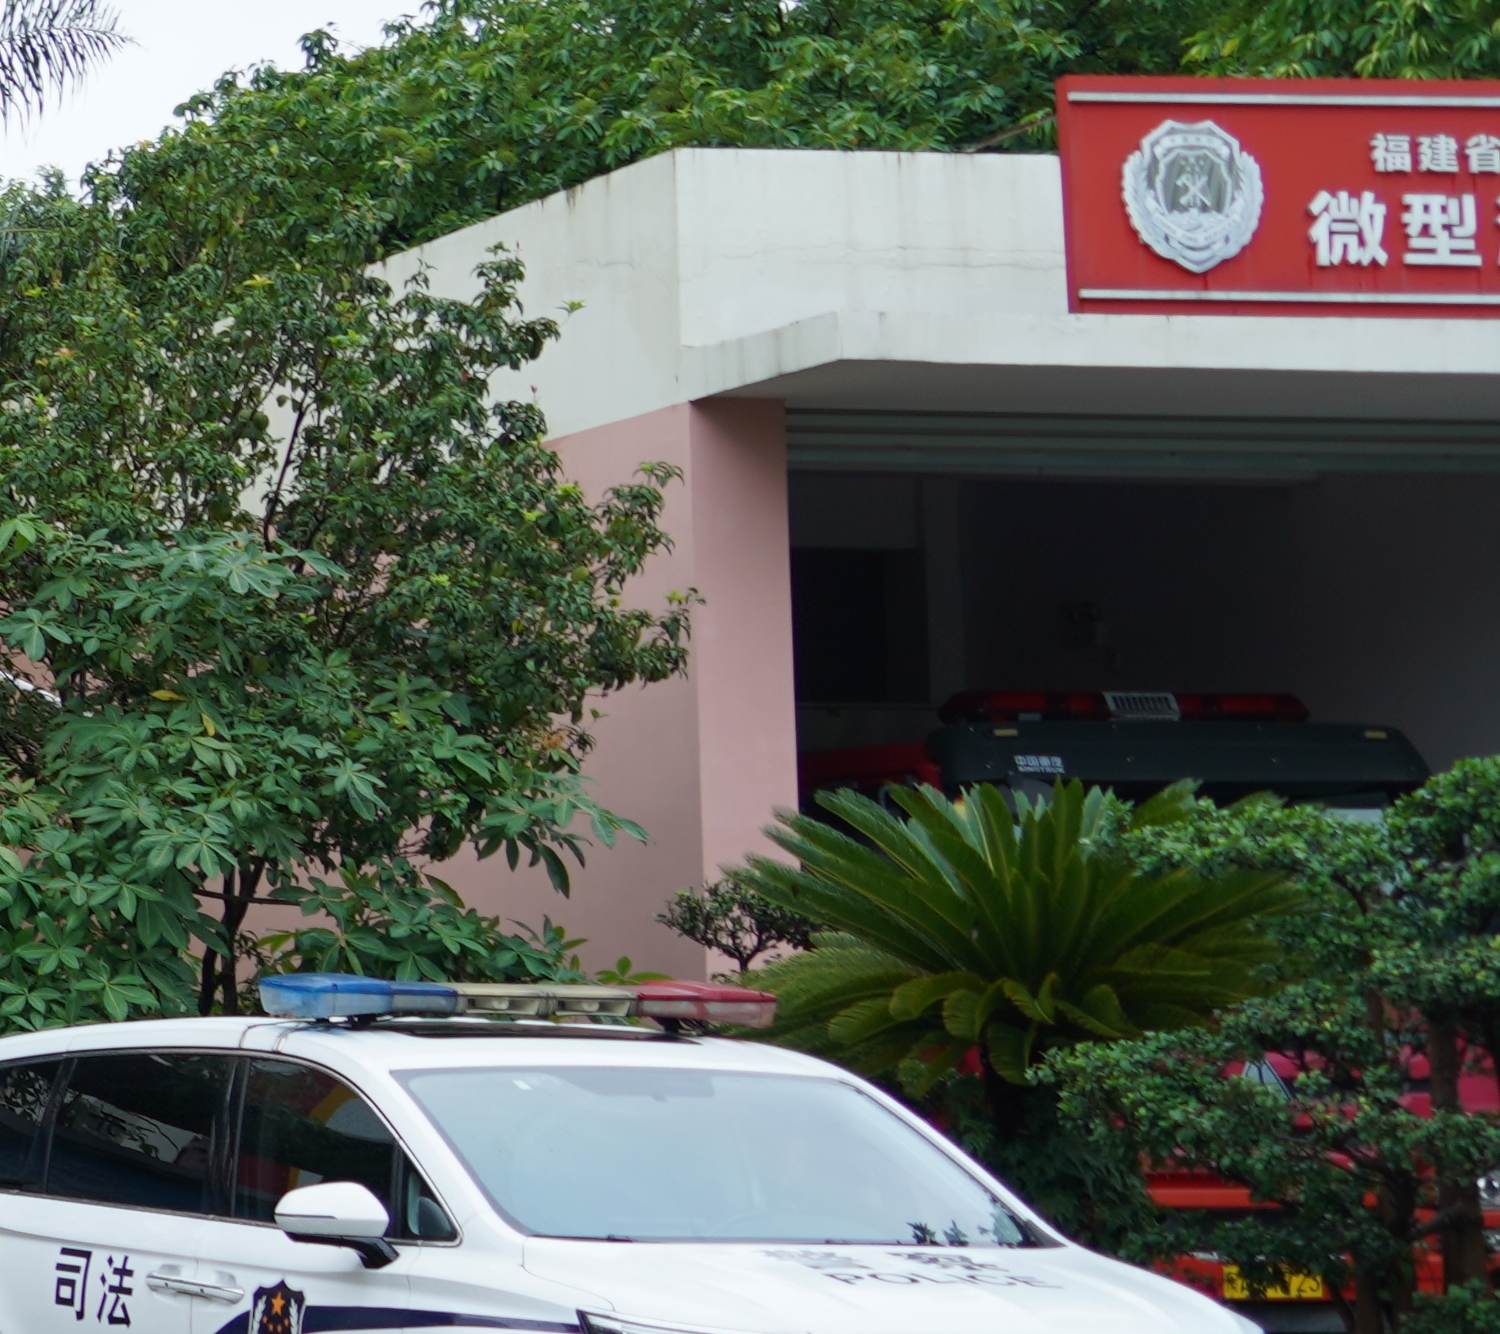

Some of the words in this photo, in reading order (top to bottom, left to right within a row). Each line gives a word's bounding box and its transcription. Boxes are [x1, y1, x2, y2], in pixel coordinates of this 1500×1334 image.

[1369, 133, 1500, 174] 福建省
[1307, 190, 1500, 267] 微型
[55, 1247, 134, 1328] 司法
[822, 1272, 1065, 1289] POLICE
